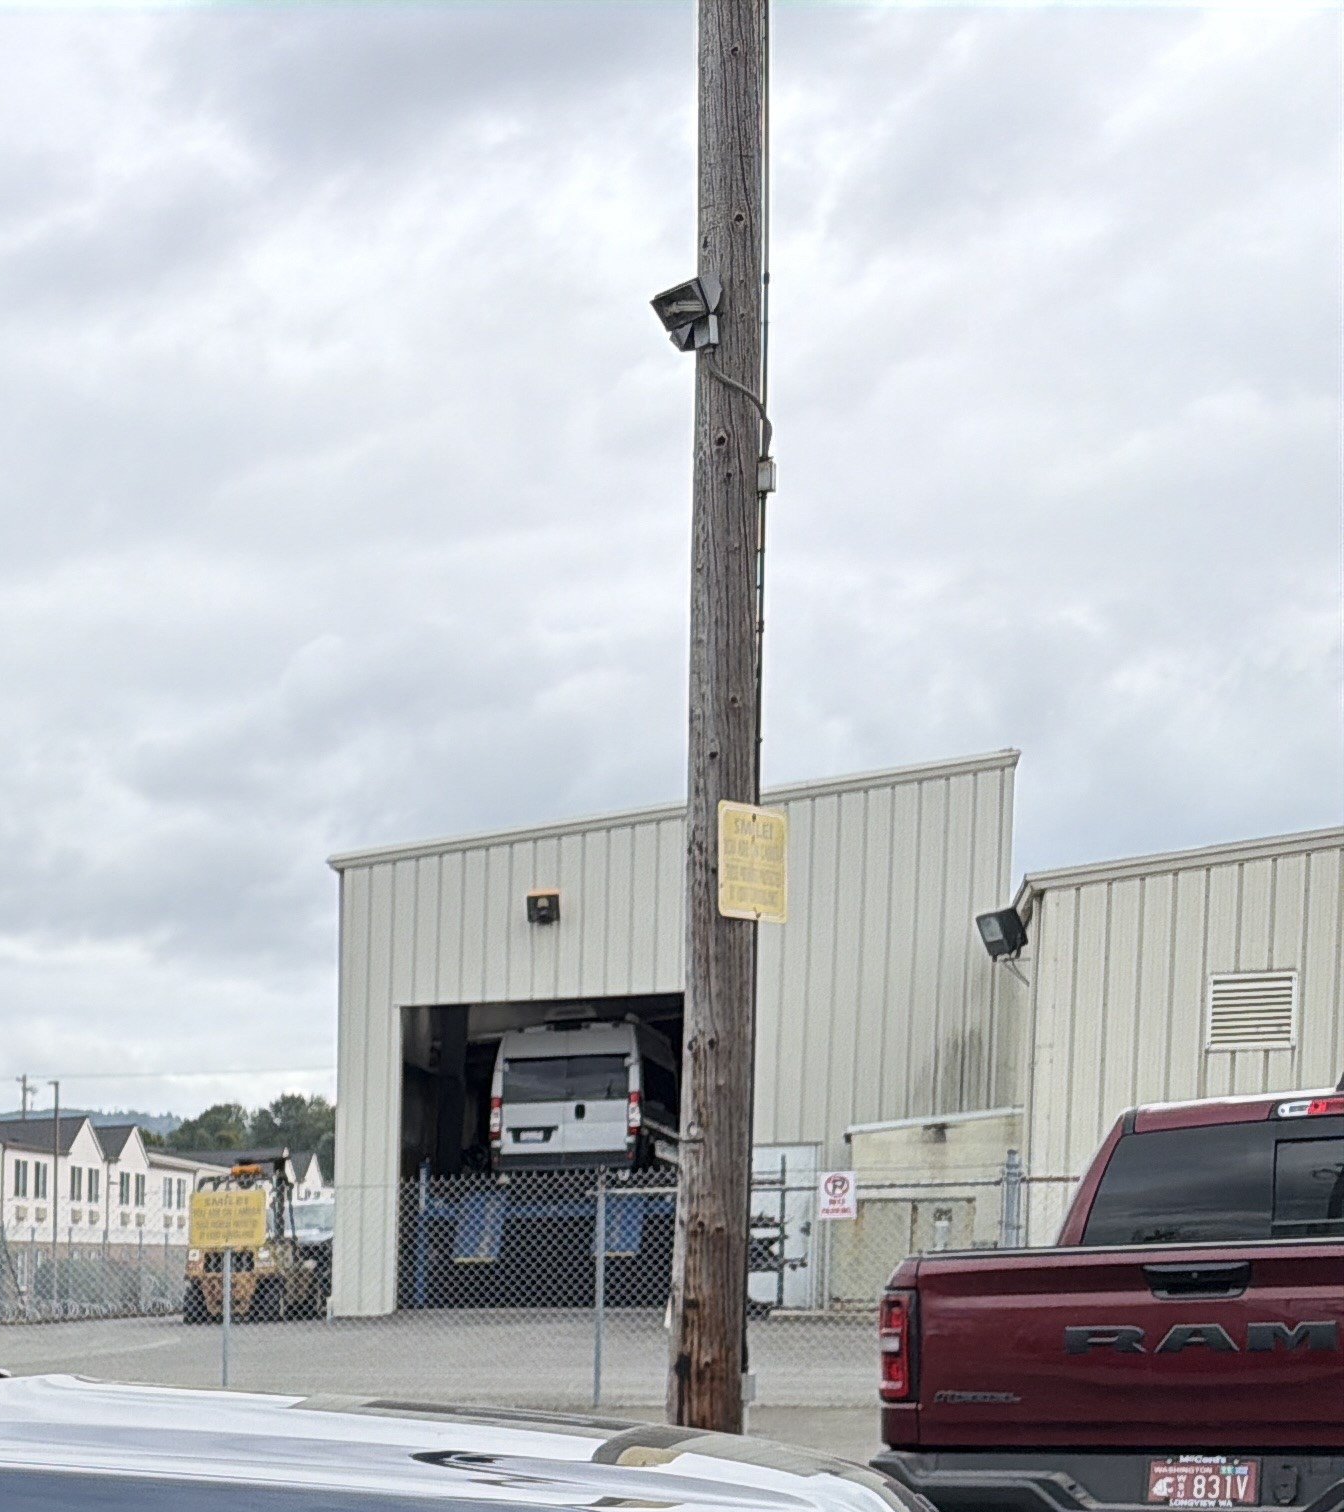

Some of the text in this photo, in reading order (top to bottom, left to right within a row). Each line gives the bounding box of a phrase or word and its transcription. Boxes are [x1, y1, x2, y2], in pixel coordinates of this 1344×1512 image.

[1064, 1319, 1338, 1353] RAM
[1153, 1466, 1213, 1474] WASHINGTON
[1192, 1474, 1249, 1500] 831V
[1169, 1499, 1233, 1508] LONGVIEW WA
